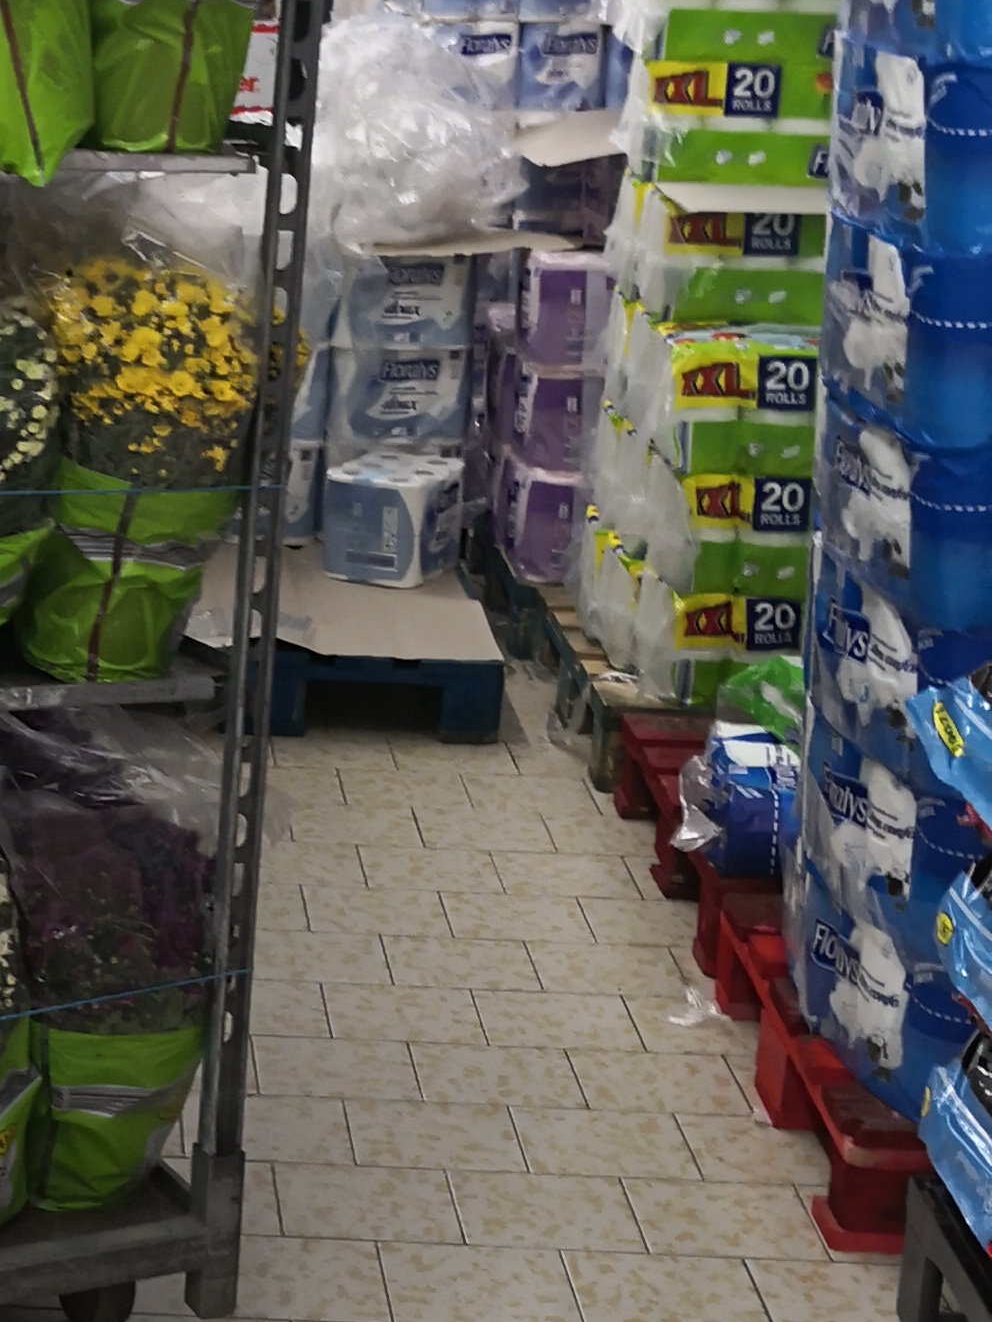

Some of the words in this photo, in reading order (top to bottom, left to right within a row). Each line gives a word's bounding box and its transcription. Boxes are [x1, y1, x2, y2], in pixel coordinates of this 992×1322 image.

[654, 71, 723, 107] XXL
[733, 66, 776, 99] 20
[732, 99, 773, 114] ROLLS
[751, 213, 795, 237] 20
[751, 236, 793, 251] ROLLS
[682, 362, 756, 401] XXL
[765, 360, 810, 392] 20
[765, 391, 807, 406] ROLLS
[761, 481, 805, 513] 20
[754, 601, 796, 632] 20
